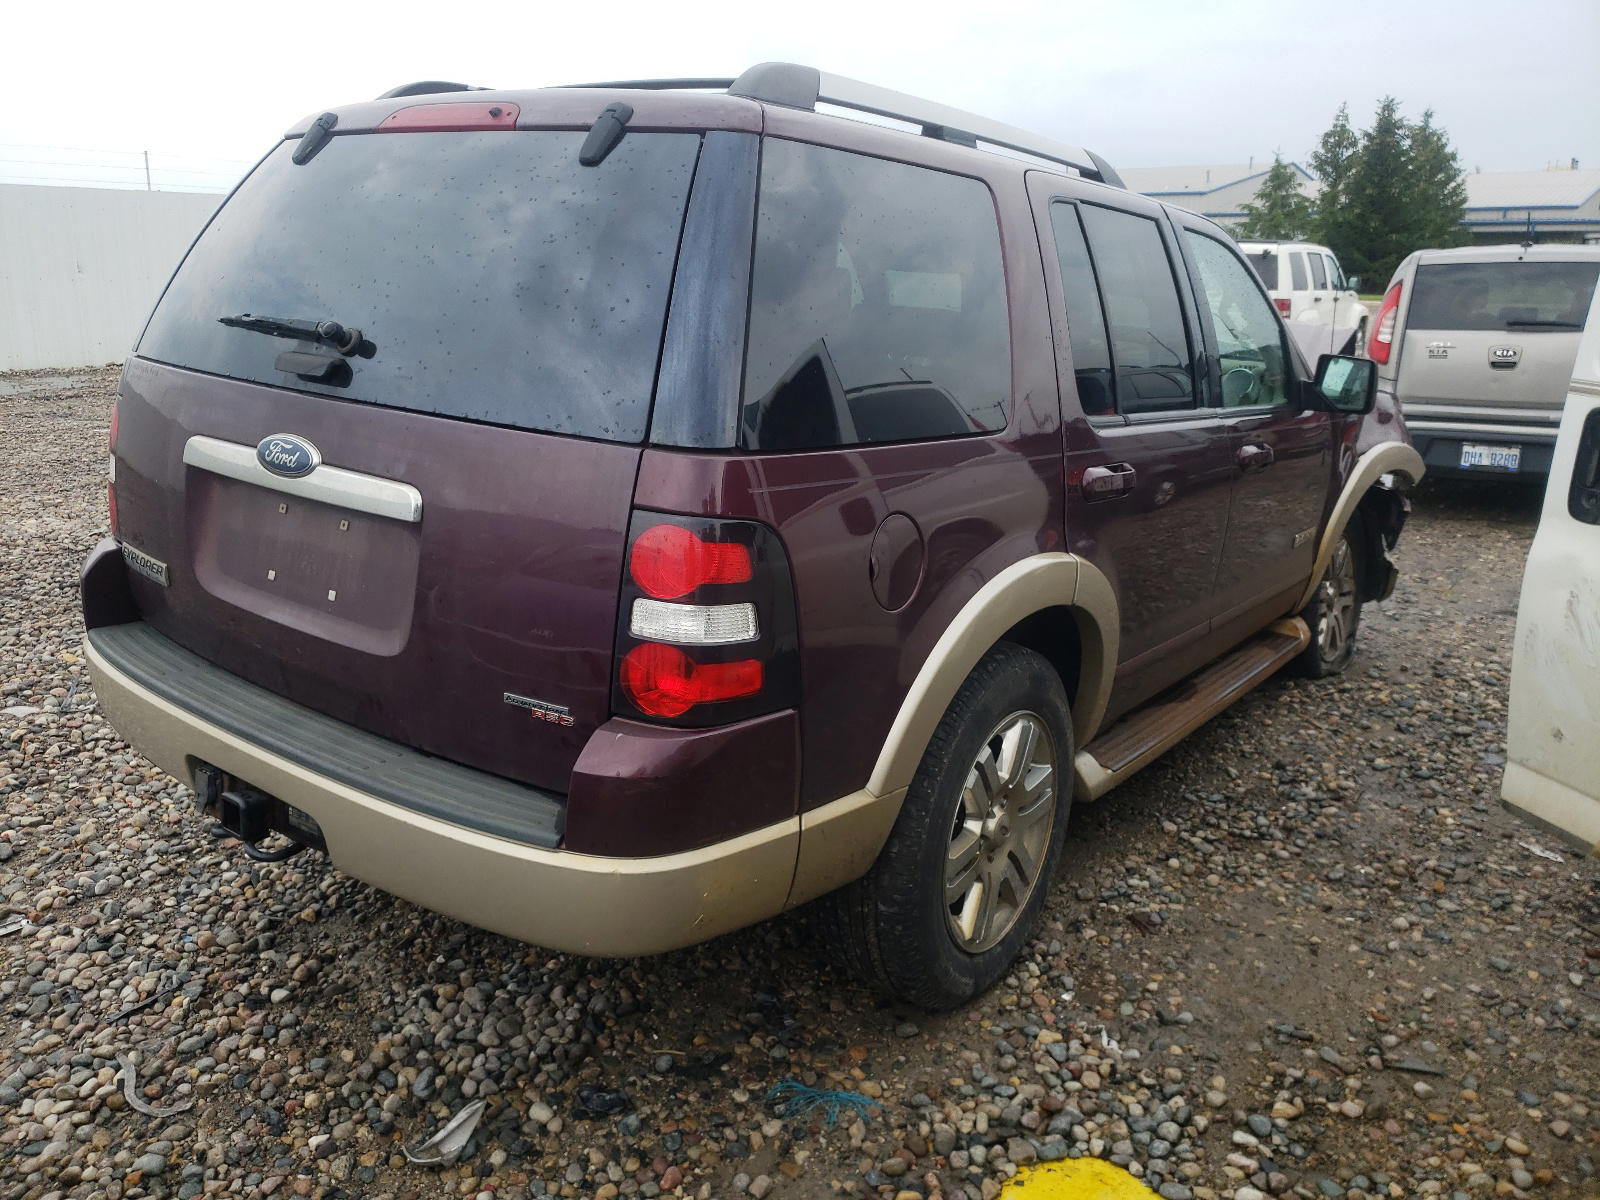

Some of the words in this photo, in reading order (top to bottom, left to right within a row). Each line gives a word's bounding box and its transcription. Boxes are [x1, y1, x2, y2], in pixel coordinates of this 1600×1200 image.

[1495, 349, 1514, 357] KIA
[264, 440, 301, 468] Ford
[123, 546, 163, 578] EXPLORER
